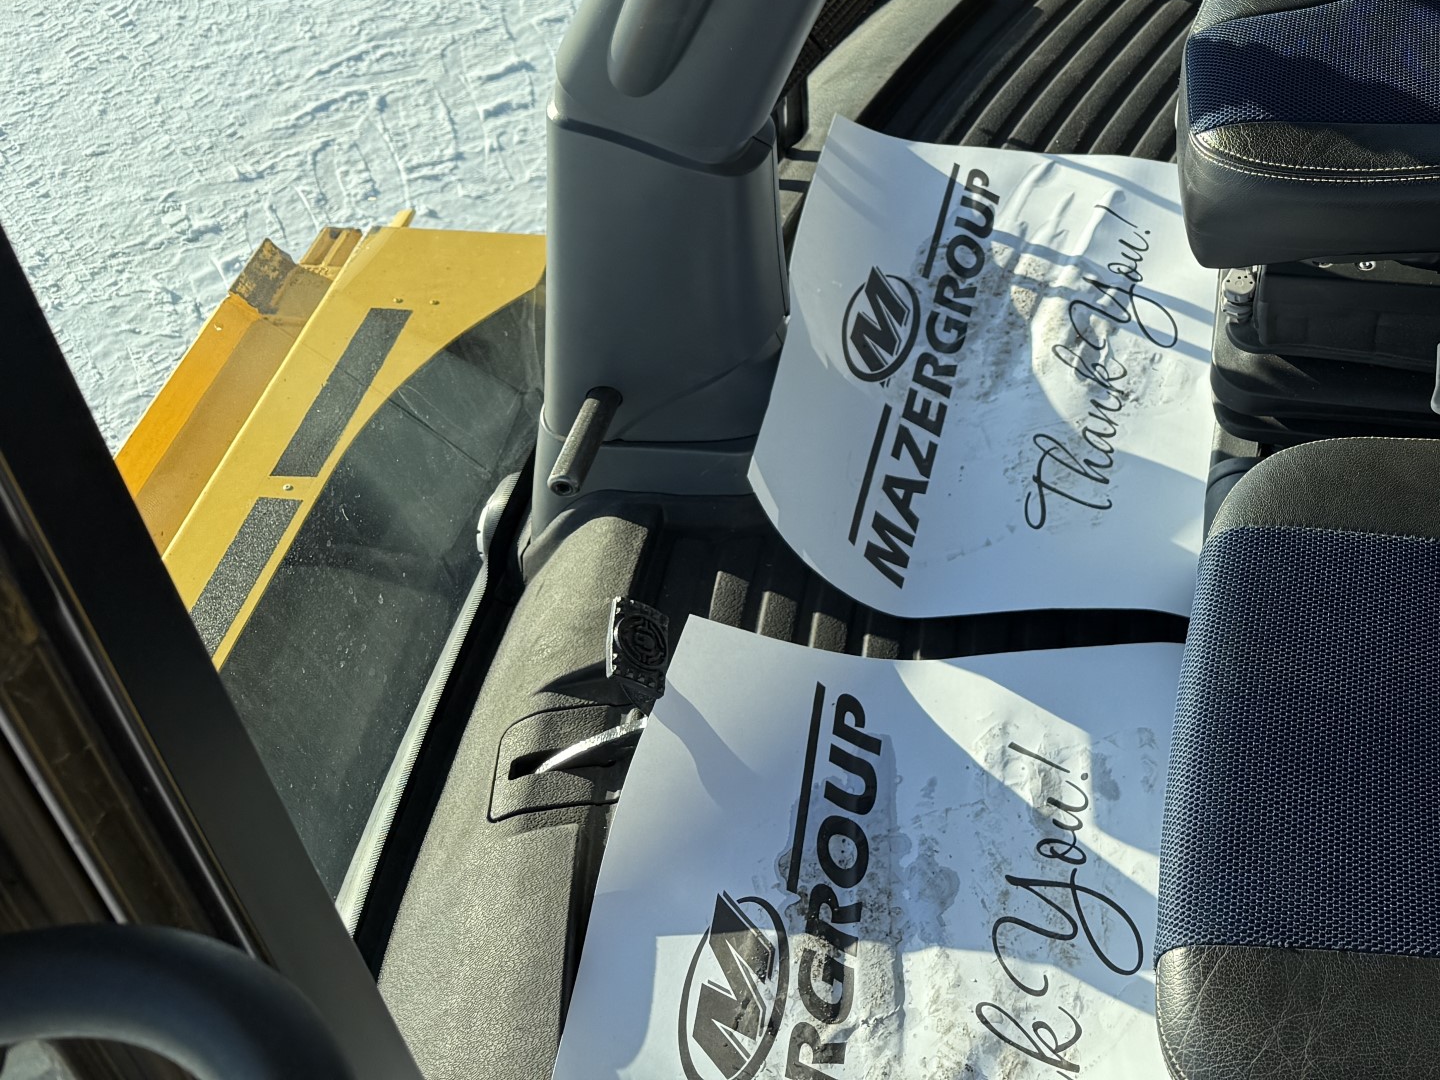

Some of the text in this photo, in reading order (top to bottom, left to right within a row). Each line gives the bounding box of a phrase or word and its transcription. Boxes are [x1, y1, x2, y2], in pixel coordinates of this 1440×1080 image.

[863, 167, 1000, 589] MAZERGROUP
[1024, 203, 1178, 530] Thank You!
[991, 741, 1144, 997] You!
